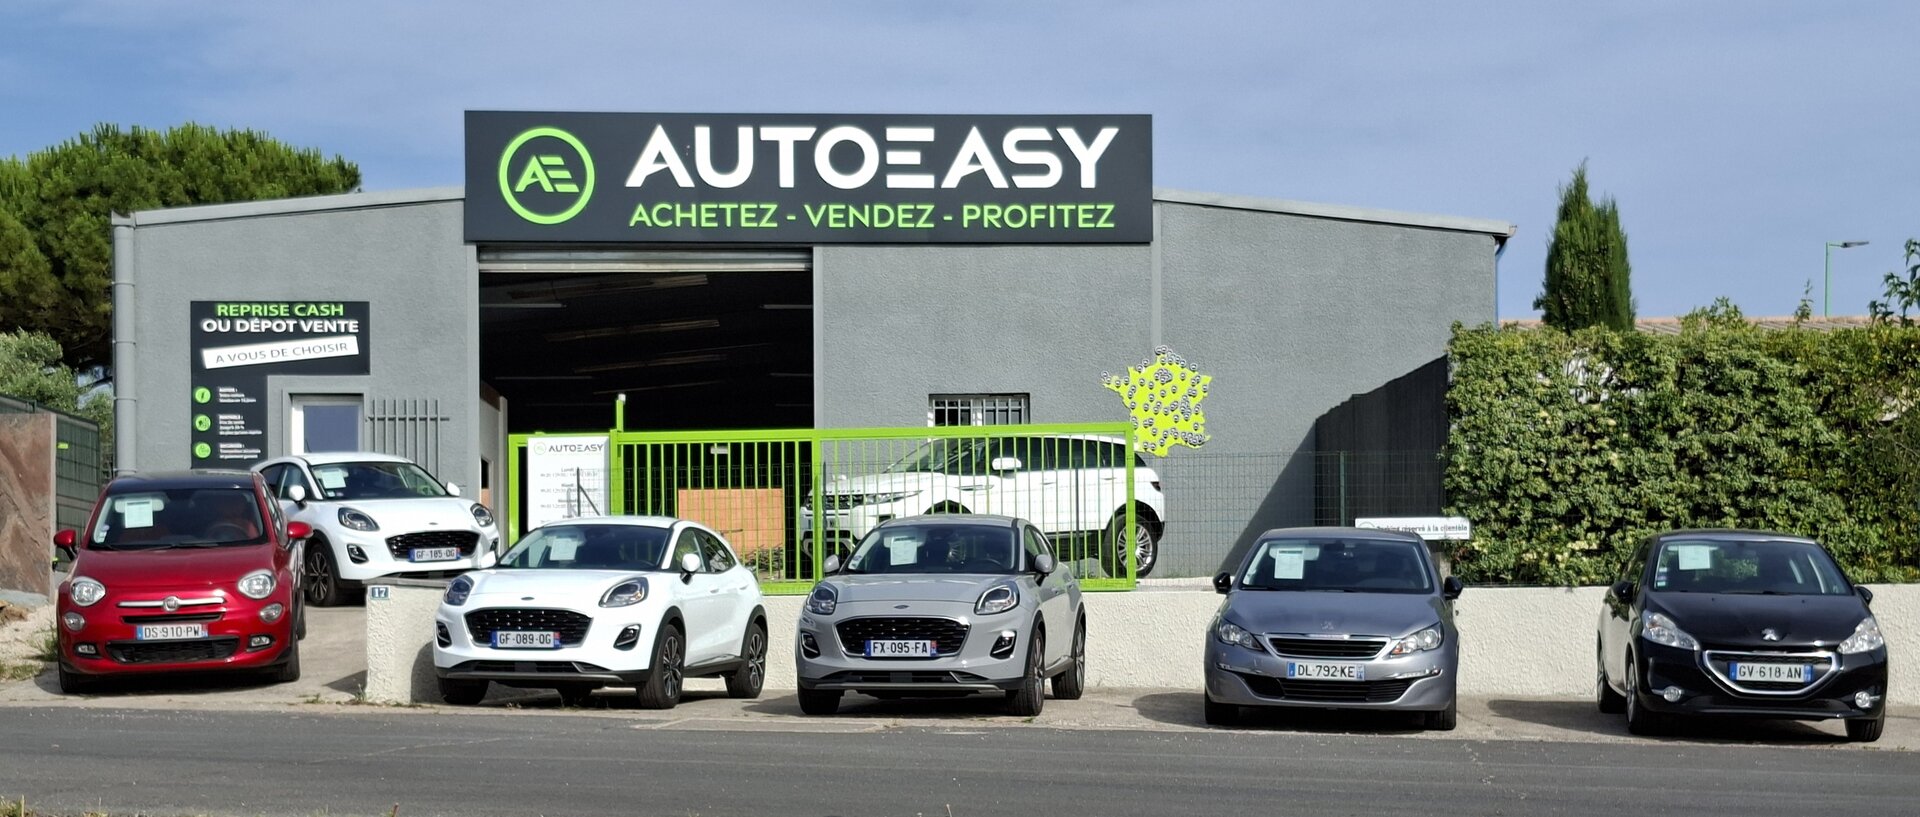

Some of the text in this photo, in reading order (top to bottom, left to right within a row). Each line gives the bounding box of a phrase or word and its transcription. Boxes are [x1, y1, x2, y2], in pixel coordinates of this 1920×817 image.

[624, 123, 1119, 190] AUTOEASY
[629, 203, 778, 229] ACHETEZ
[804, 204, 934, 229] VENDEZ
[962, 204, 1115, 229] PROFITEZ
[217, 304, 344, 317] REPRISE CASH
[202, 318, 359, 333] OU DÉPOT VENTE
[215, 342, 348, 364] A VOUS DE CHOISIR
[549, 444, 603, 452] AUTOEASY
[374, 587, 386, 598] 17
[873, 642, 928, 653] FX-095-FA
[1297, 664, 1355, 678] DL-792-KE
[1739, 665, 1802, 679] GV-618-AN
